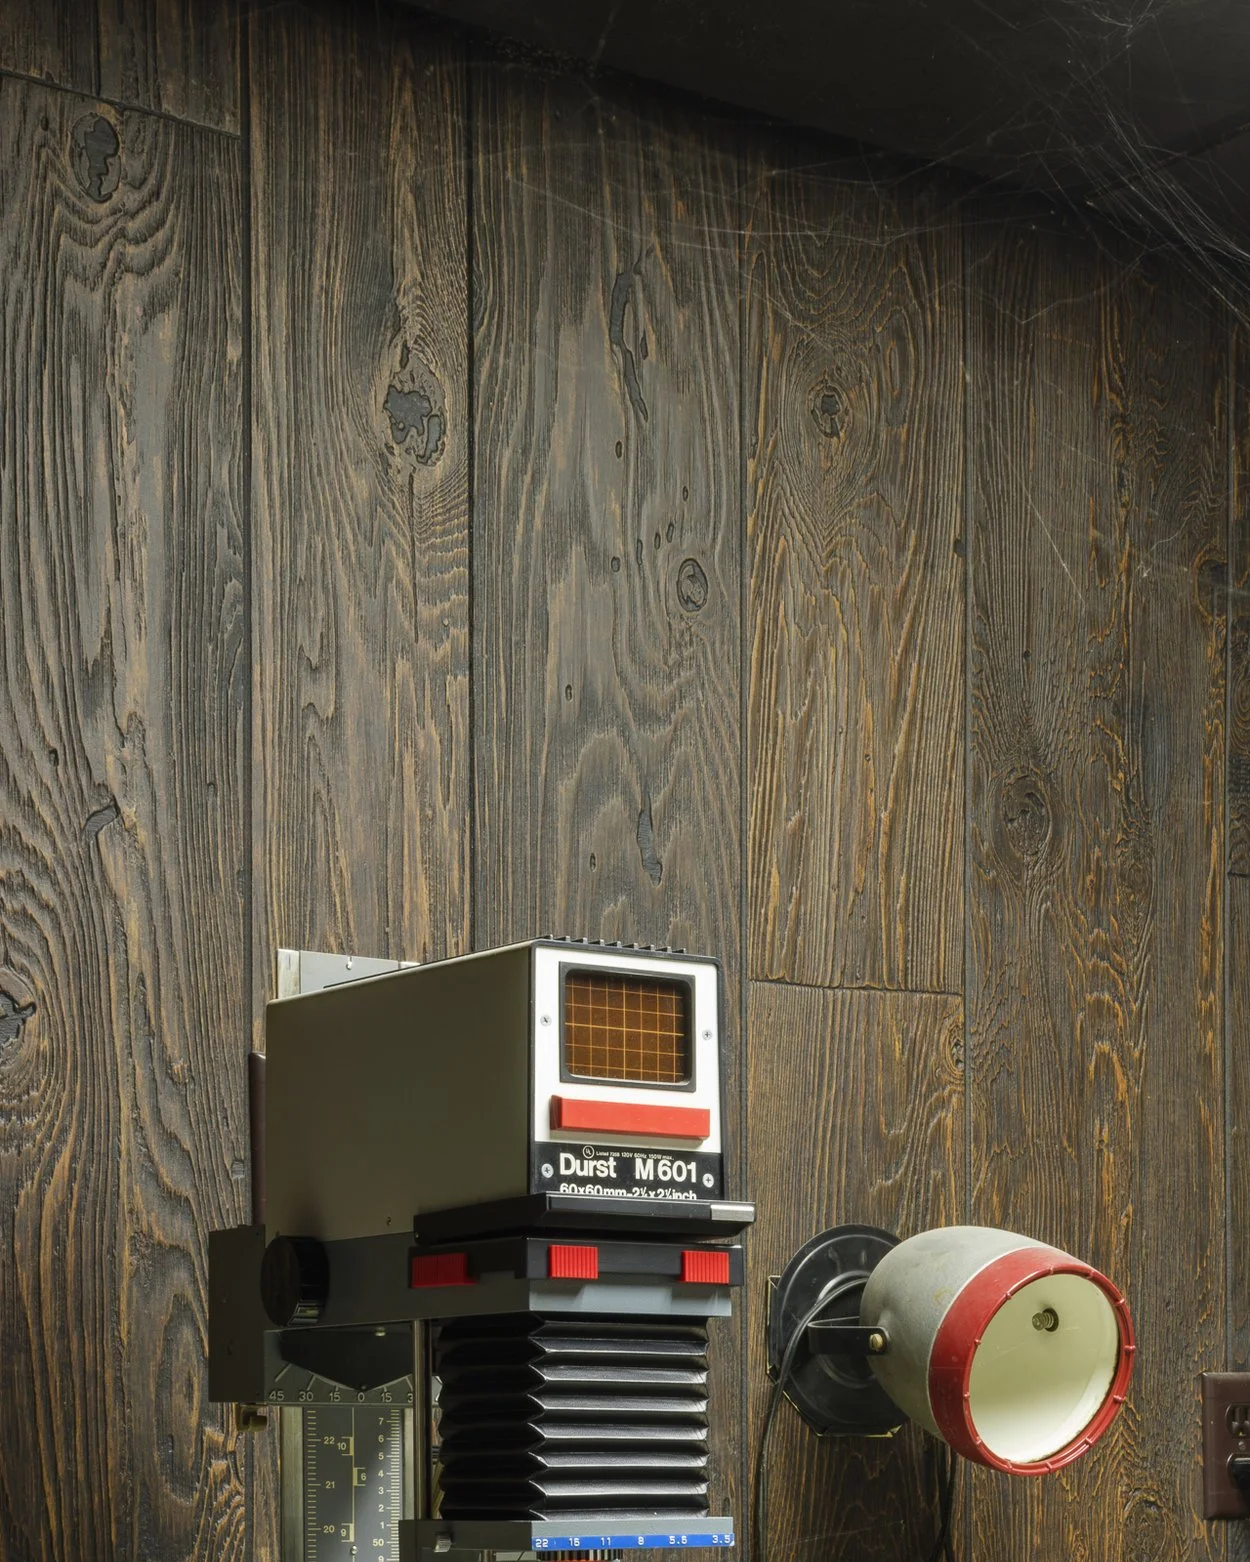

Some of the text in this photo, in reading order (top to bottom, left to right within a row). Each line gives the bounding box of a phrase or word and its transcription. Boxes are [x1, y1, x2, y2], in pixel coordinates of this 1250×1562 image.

[560, 1153, 616, 1178] Durst
[269, 1390, 284, 1400] 45
[300, 1392, 314, 1400] 30
[330, 1392, 340, 1402] 15
[358, 1392, 365, 1402] 0
[381, 1392, 392, 1402] 15
[324, 1436, 334, 1444] 22
[324, 1525, 334, 1533] 20
[535, 1539, 548, 1548] 22
[600, 1538, 611, 1546] 11
[712, 1535, 730, 1544] 3.5
